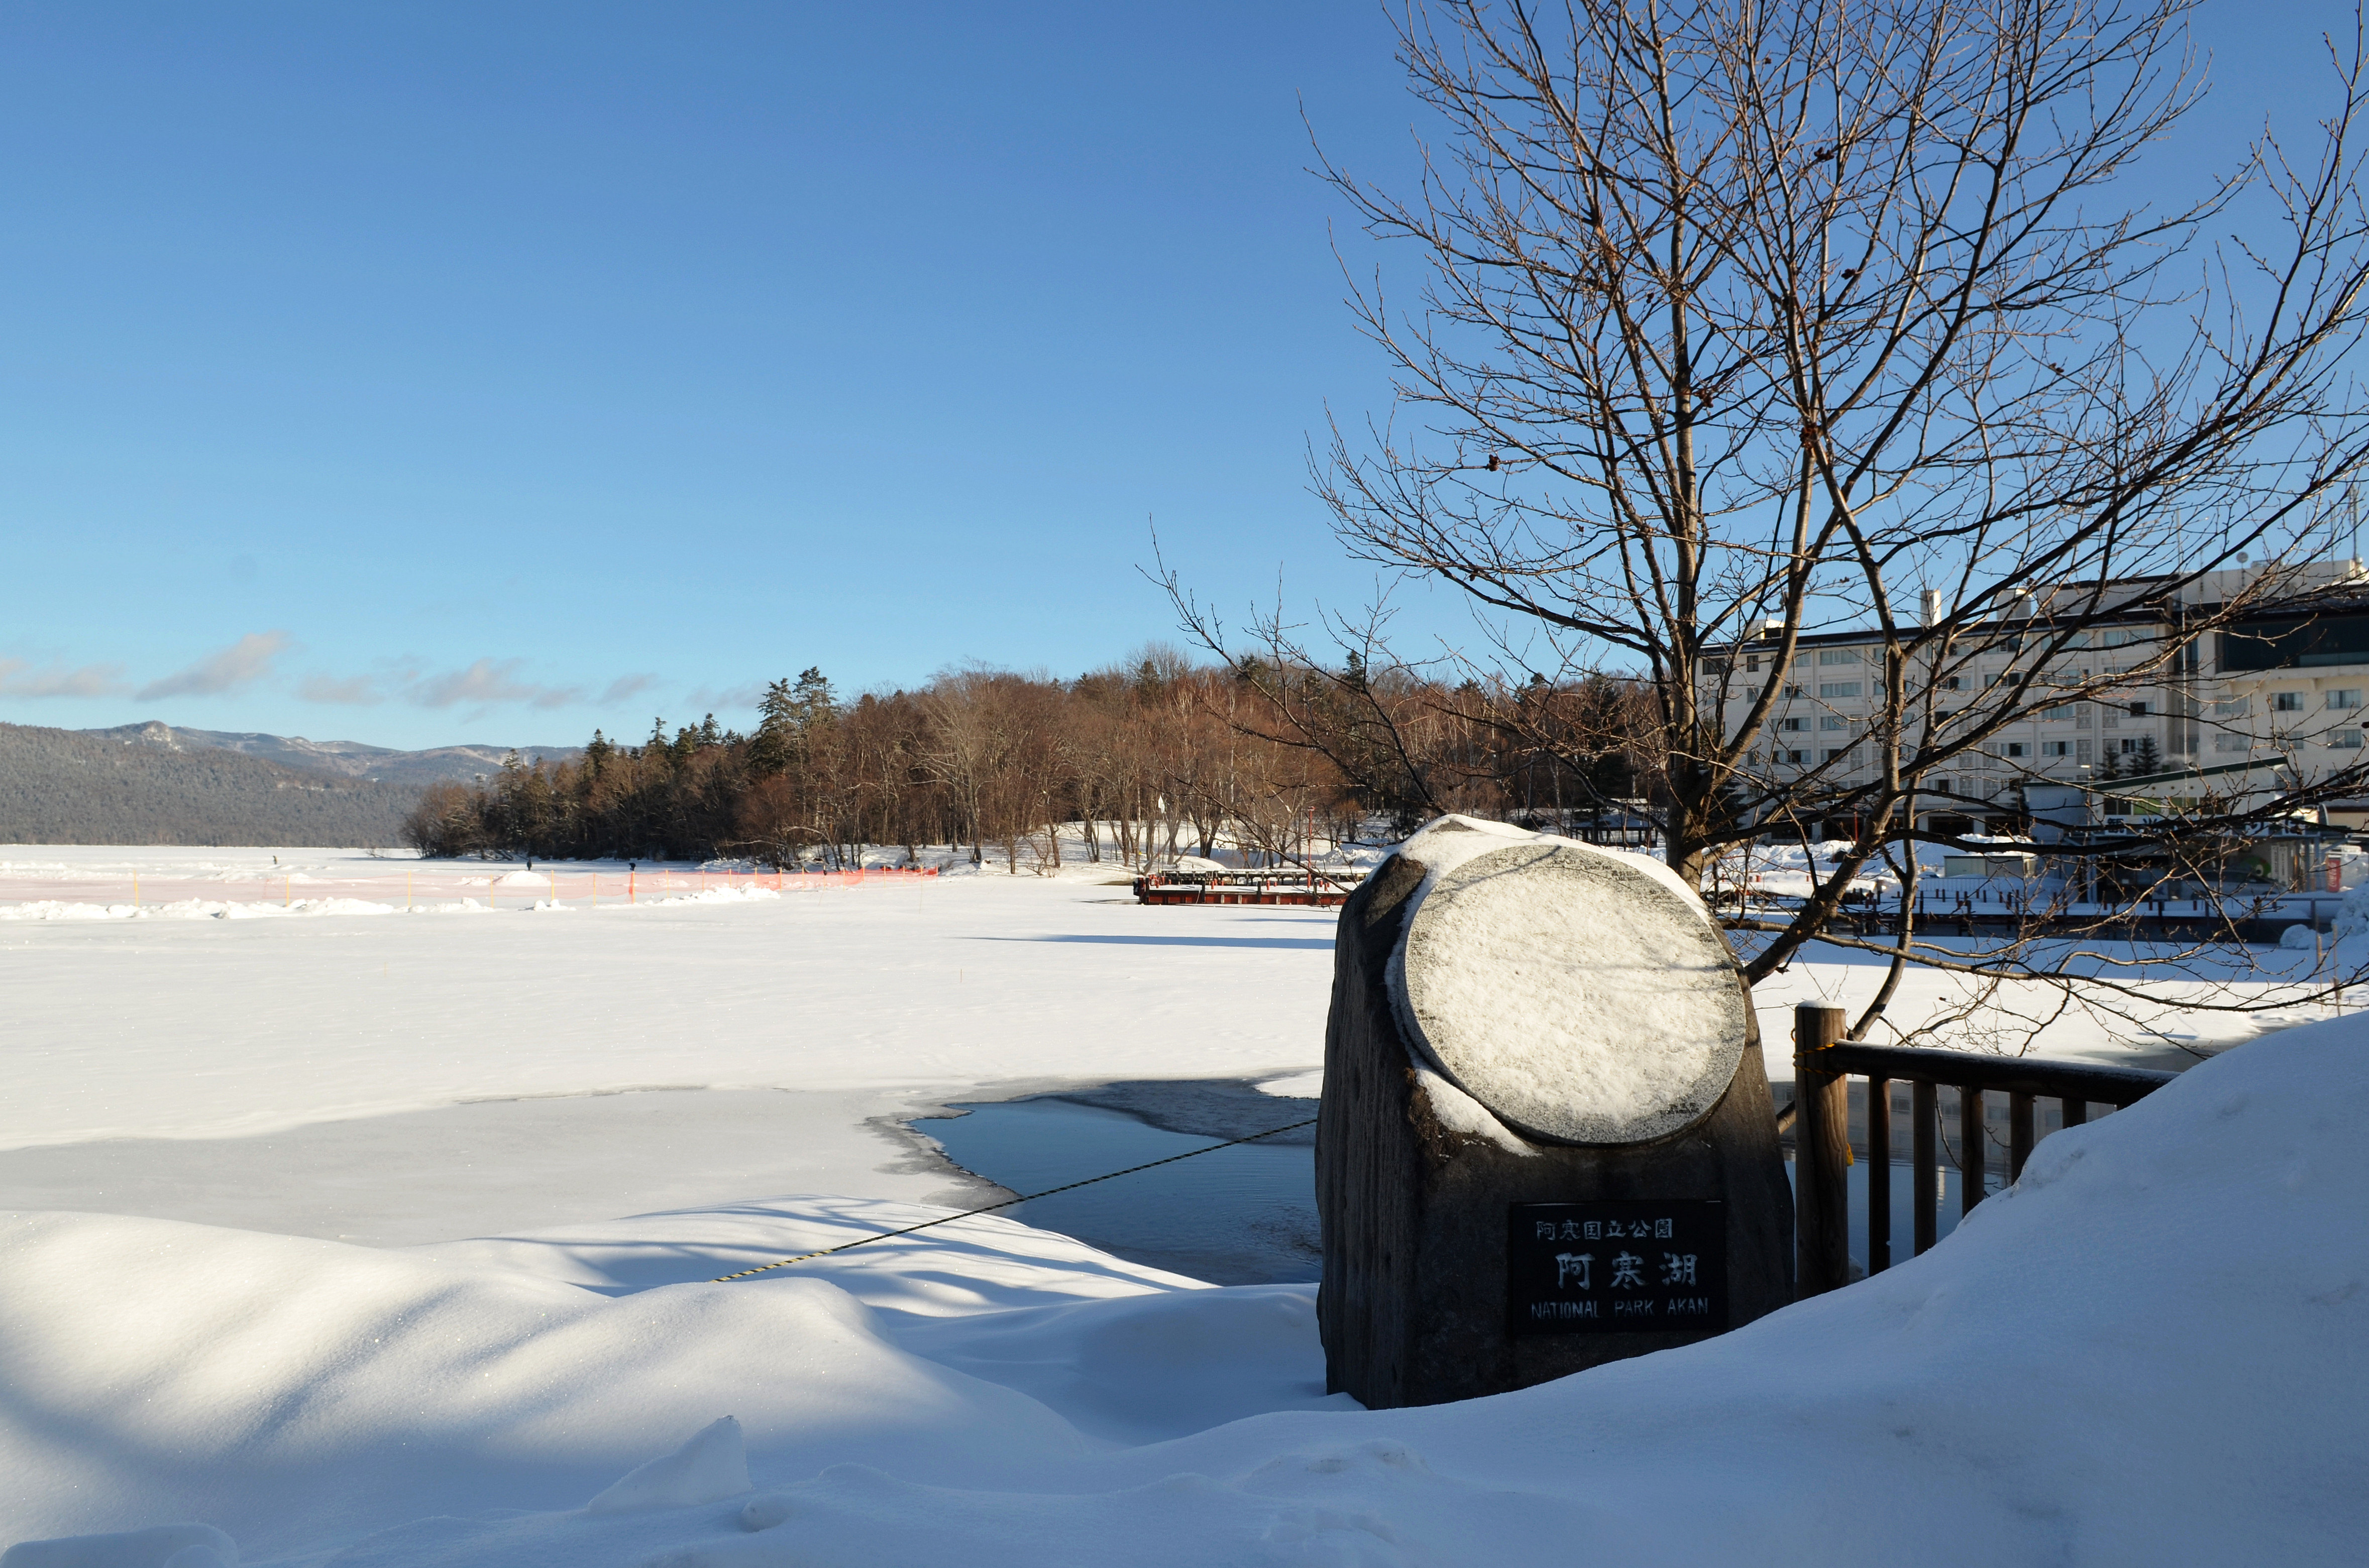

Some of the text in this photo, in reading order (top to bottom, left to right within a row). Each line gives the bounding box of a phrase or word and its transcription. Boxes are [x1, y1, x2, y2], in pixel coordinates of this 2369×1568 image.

[1536, 1218, 1673, 1241] 阿寒国立公園
[1555, 1250, 1698, 1290] 阿寒湖
[1531, 1297, 1708, 1319] NATIONAL PARK AKAN
